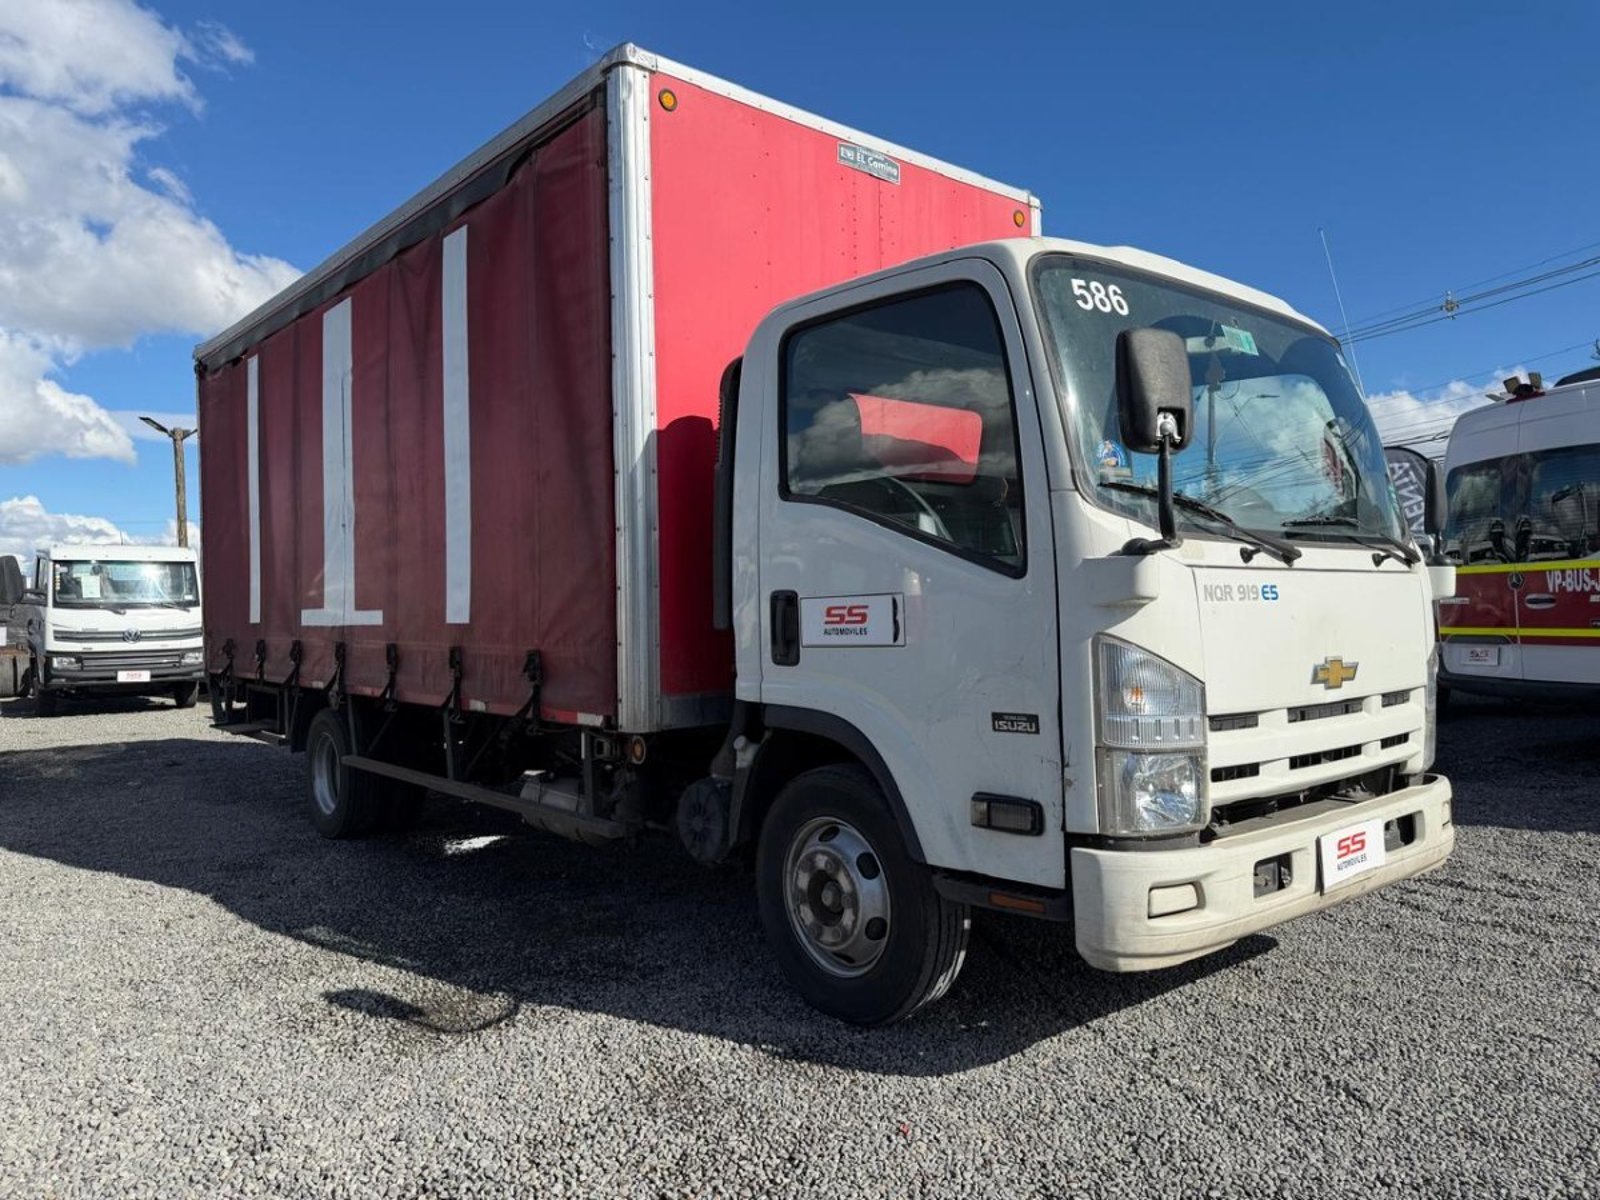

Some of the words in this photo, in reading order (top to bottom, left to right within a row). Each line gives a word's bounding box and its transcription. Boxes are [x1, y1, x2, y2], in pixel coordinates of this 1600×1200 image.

[1070, 278, 1129, 316] 586
[1203, 584, 1234, 602] NQR
[1237, 584, 1260, 601] 919
[824, 605, 869, 625] SS
[823, 627, 868, 636] AUTOMOVILES
[994, 720, 1036, 732] ISUZU
[1336, 831, 1366, 860] SS
